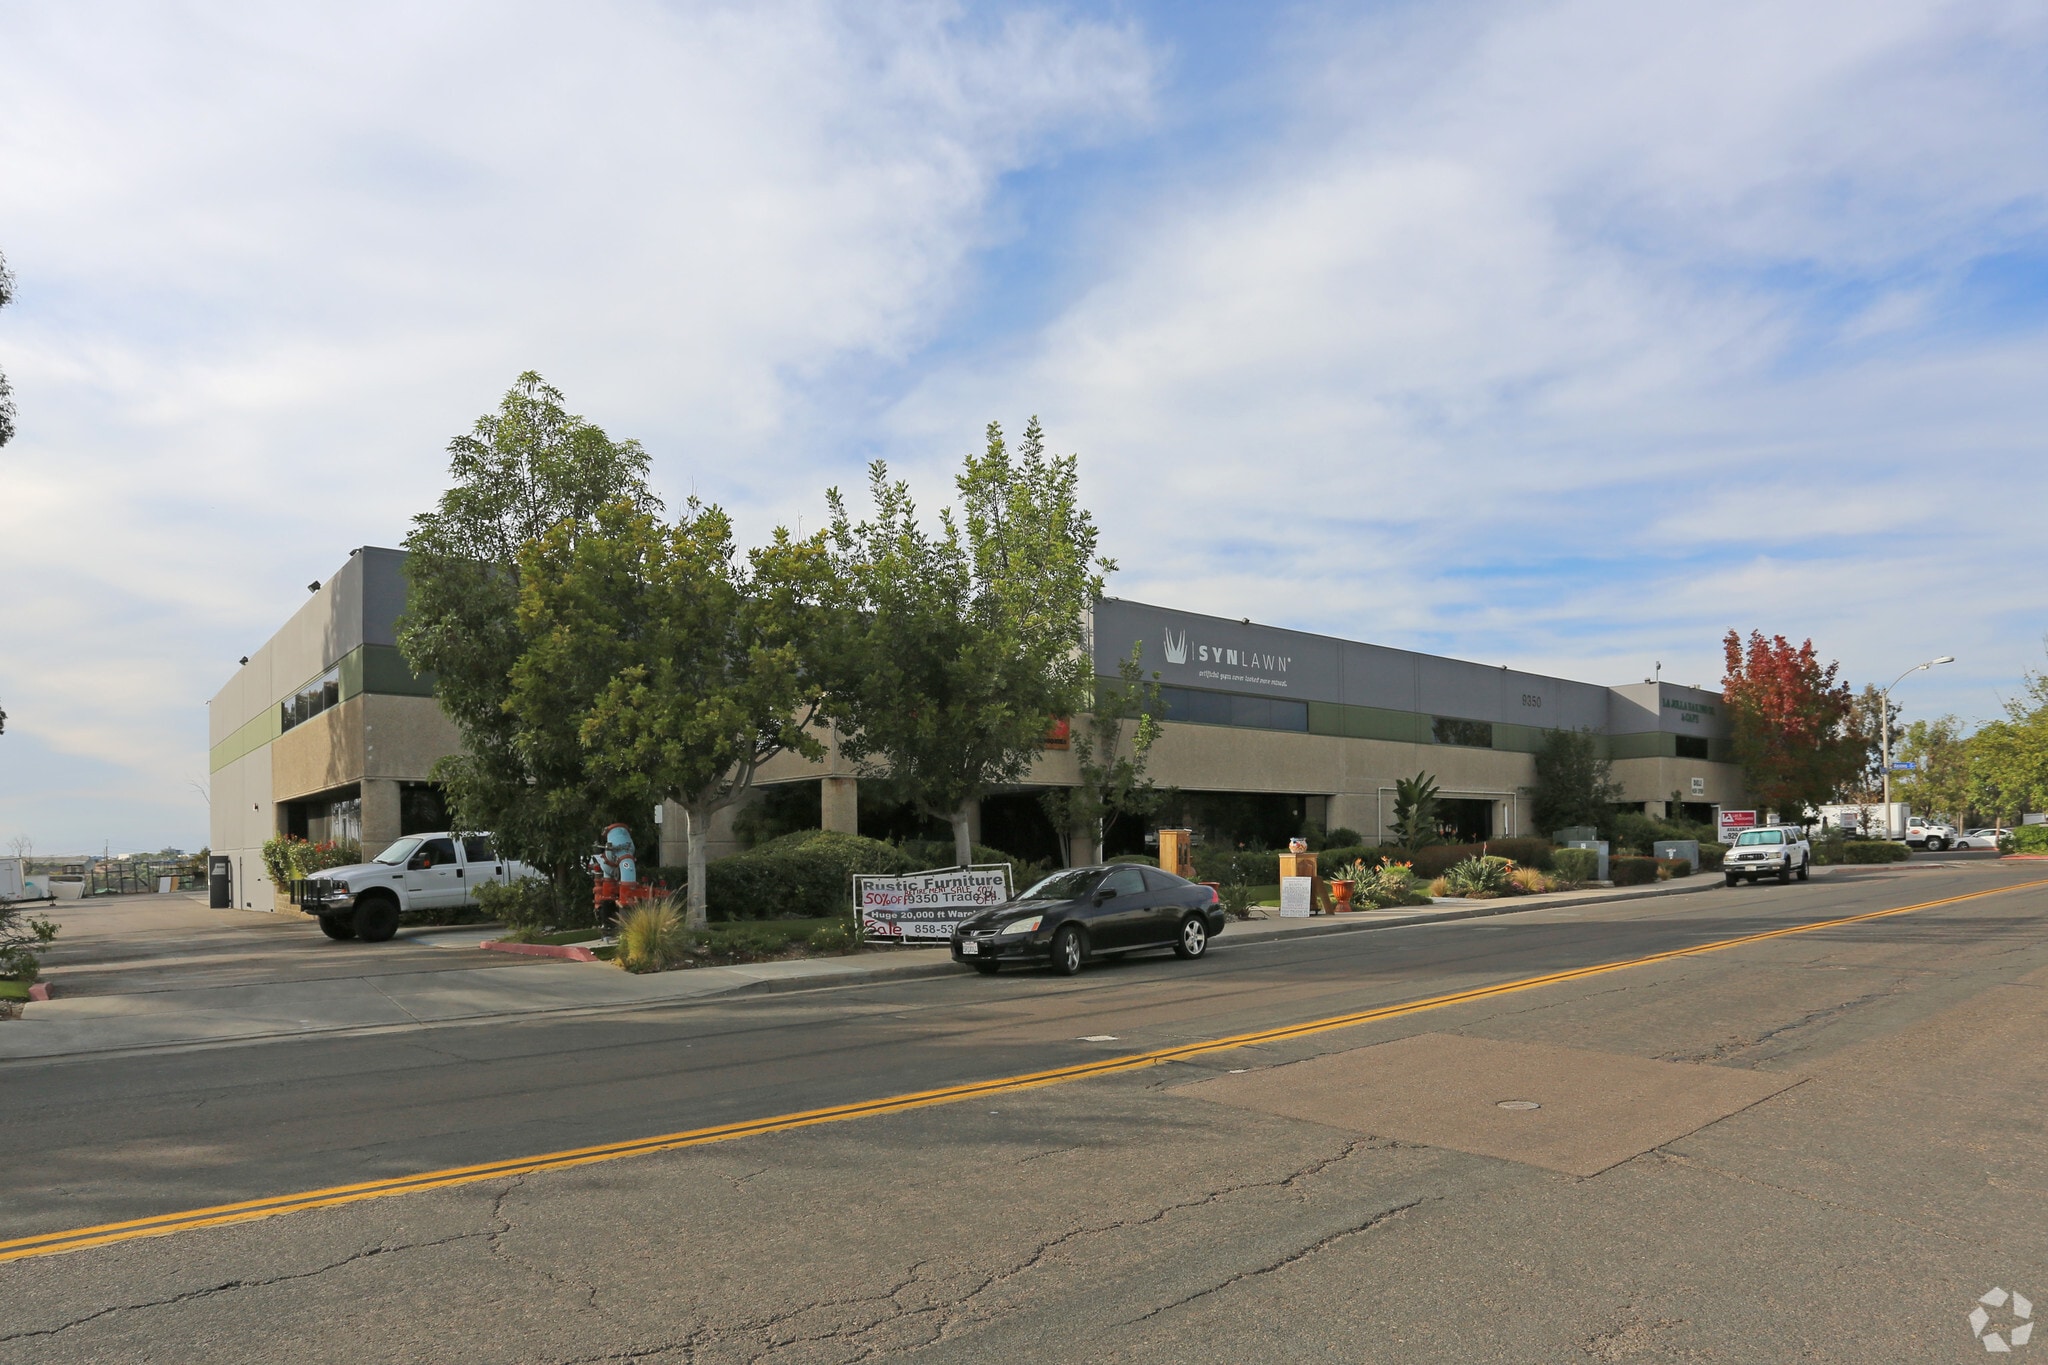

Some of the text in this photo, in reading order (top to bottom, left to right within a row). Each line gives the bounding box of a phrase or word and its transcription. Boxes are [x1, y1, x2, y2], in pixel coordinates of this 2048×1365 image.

[1522, 694, 1542, 708] 9350
[863, 874, 1003, 892] Rustic Furniture
[951, 886, 971, 894] SALE
[908, 893, 938, 904] 9350
[944, 890, 979, 902] Trade
[871, 911, 898, 920] Huge
[901, 911, 935, 920] 20,000
[936, 911, 946, 919] ft
[915, 924, 957, 934] 858-53
